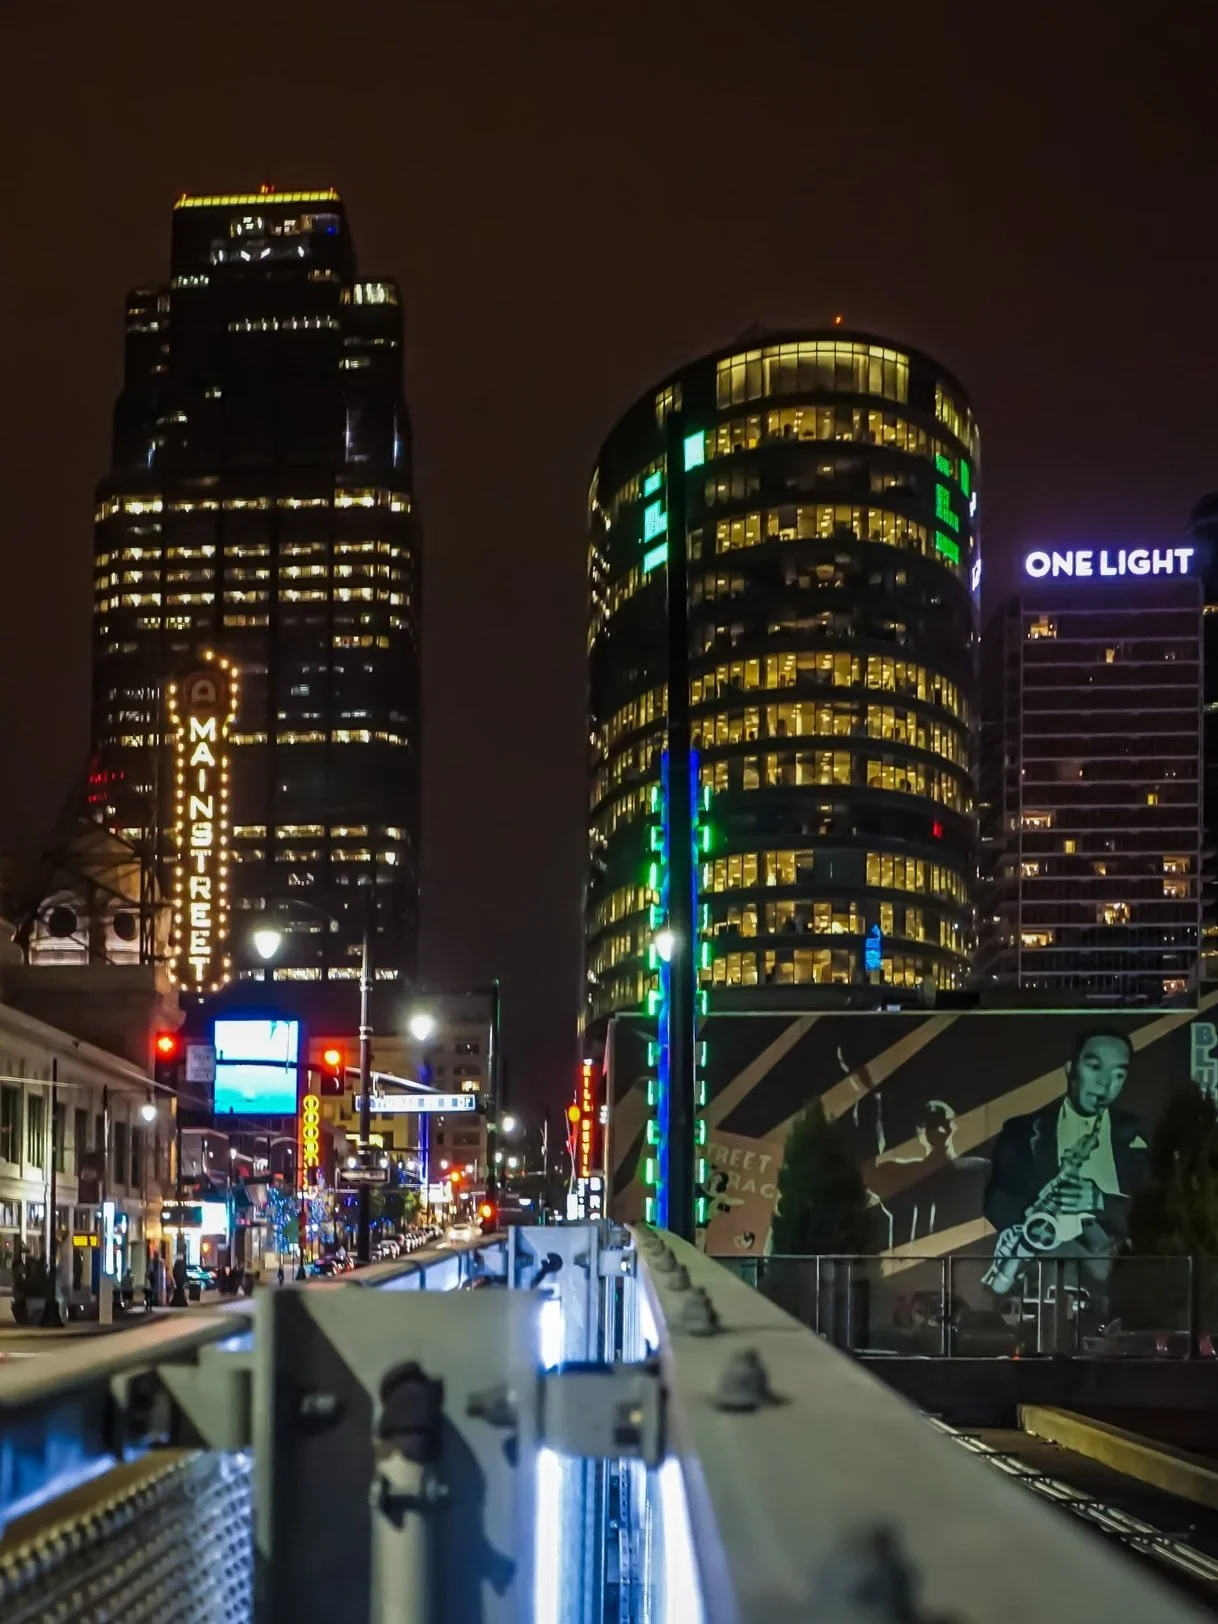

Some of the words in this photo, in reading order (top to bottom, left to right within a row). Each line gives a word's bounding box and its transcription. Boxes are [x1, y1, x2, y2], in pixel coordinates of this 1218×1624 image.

[1025, 551, 1093, 578] ONE
[1100, 548, 1194, 576] LIGHT
[696, 1142, 772, 1174] TREET
